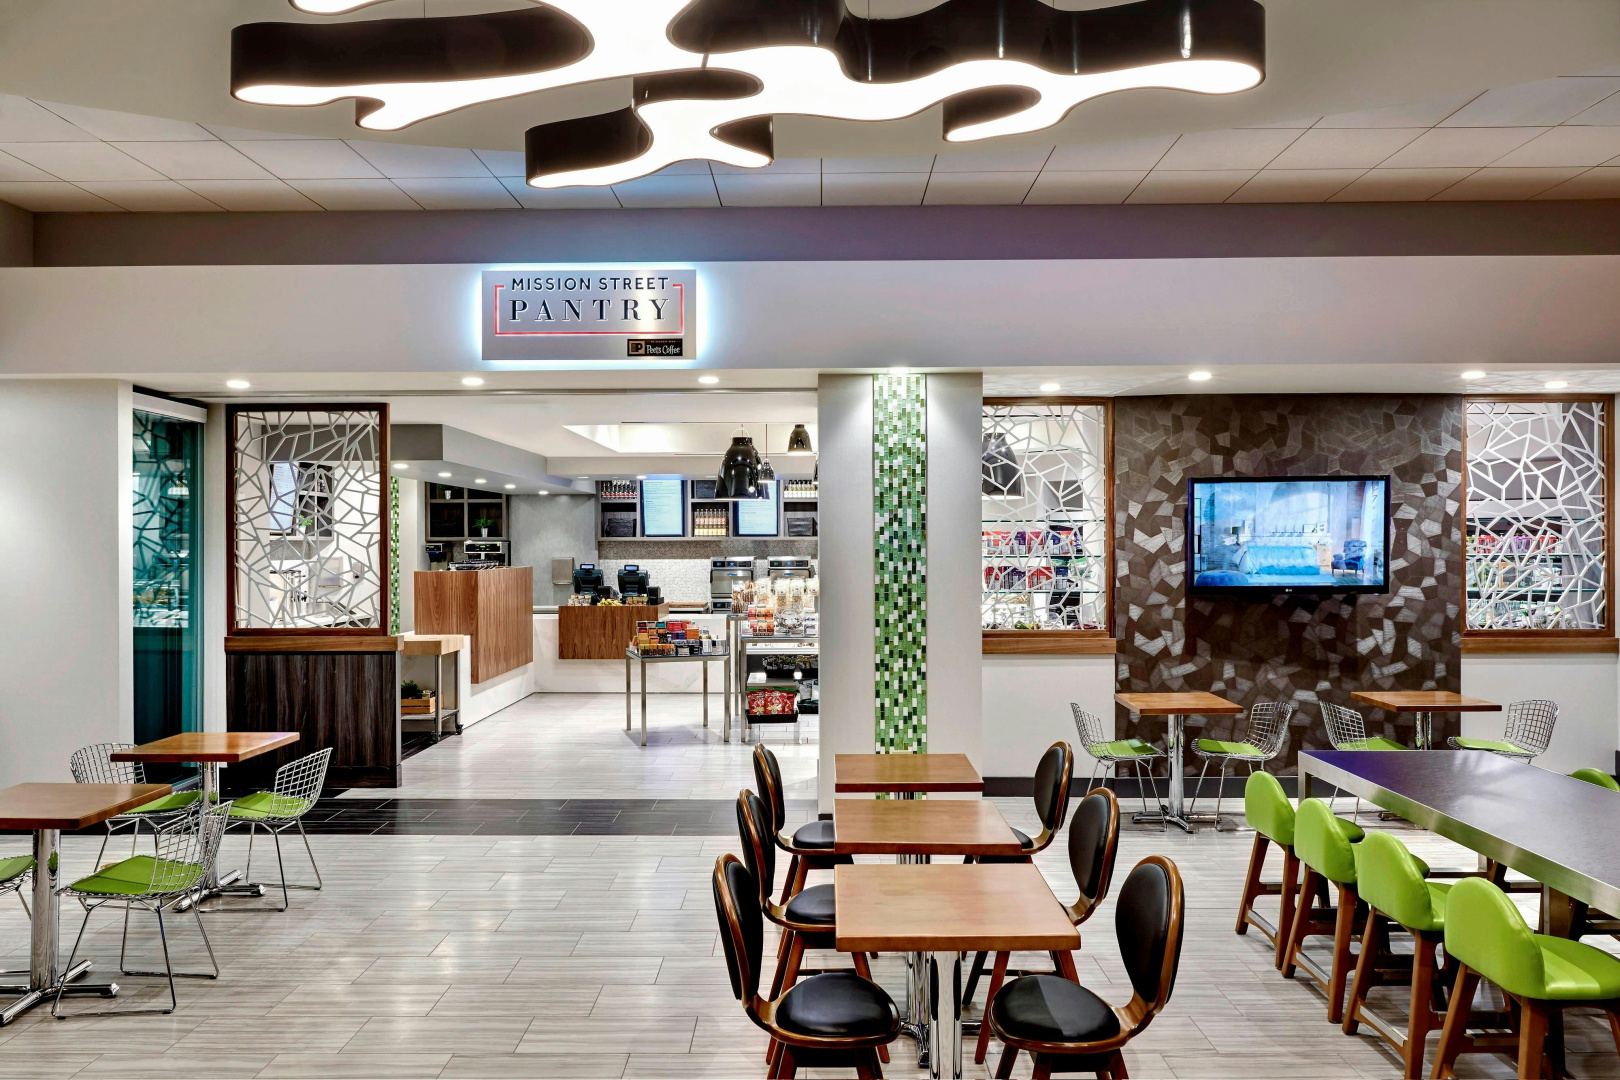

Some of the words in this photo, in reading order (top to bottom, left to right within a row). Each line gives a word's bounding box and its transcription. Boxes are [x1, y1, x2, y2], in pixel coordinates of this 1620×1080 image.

[512, 277, 591, 290] MISSION
[599, 277, 669, 290] STREET
[509, 299, 669, 321] PANTRY
[662, 344, 681, 355] Coffee
